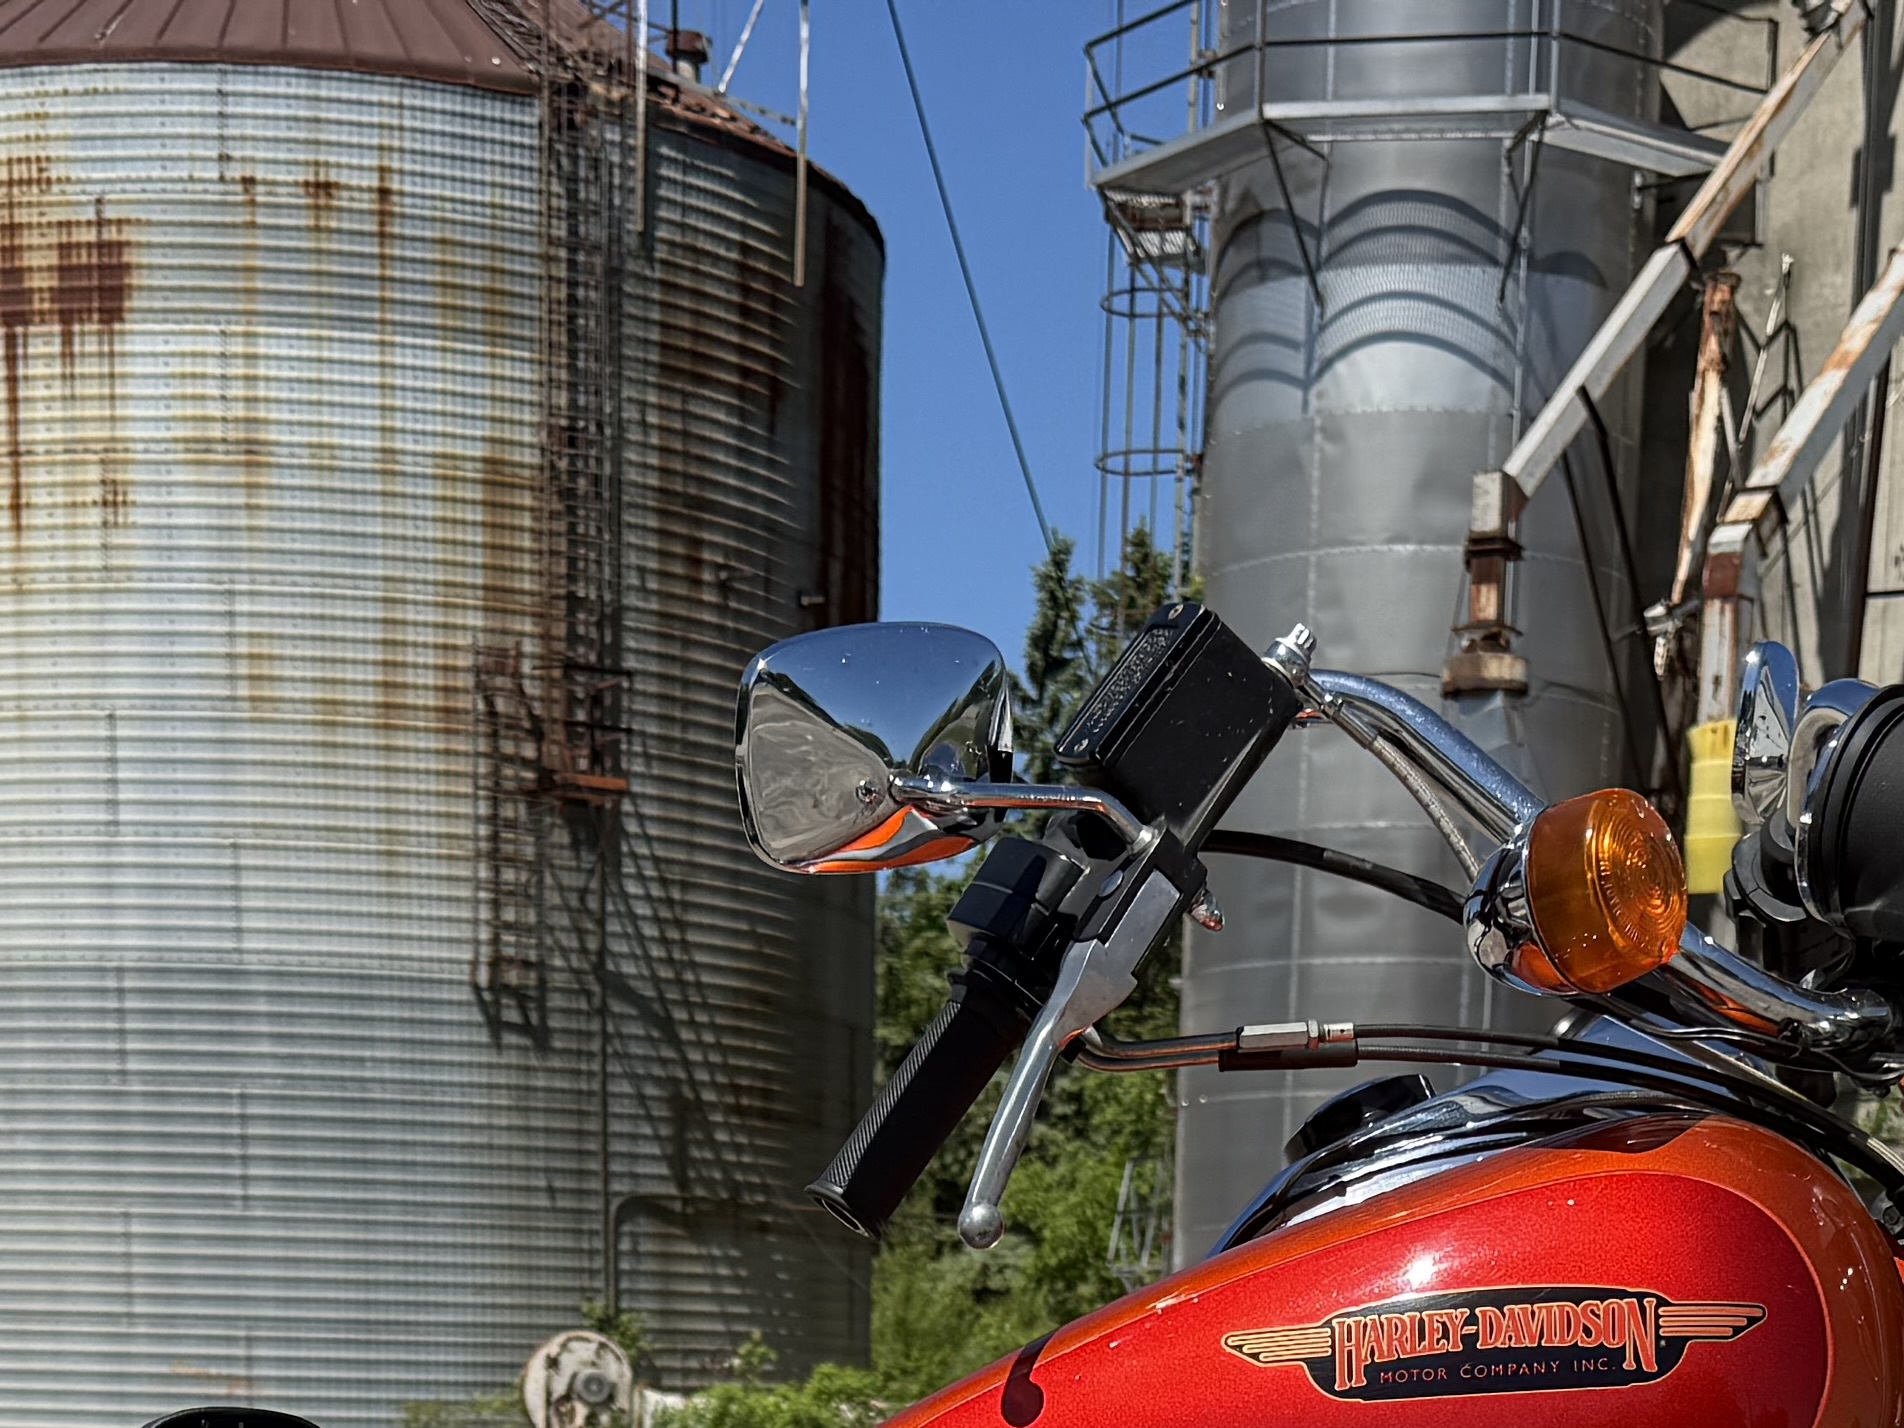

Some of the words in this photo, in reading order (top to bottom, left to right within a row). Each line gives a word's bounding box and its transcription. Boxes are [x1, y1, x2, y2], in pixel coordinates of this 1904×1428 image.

[1333, 1297, 1658, 1391] HARLEY-DAVIDSON
[1379, 1365, 1448, 1384] MOTOR
[1460, 1360, 1560, 1380] COMPANY
[1573, 1356, 1617, 1374] INC.
